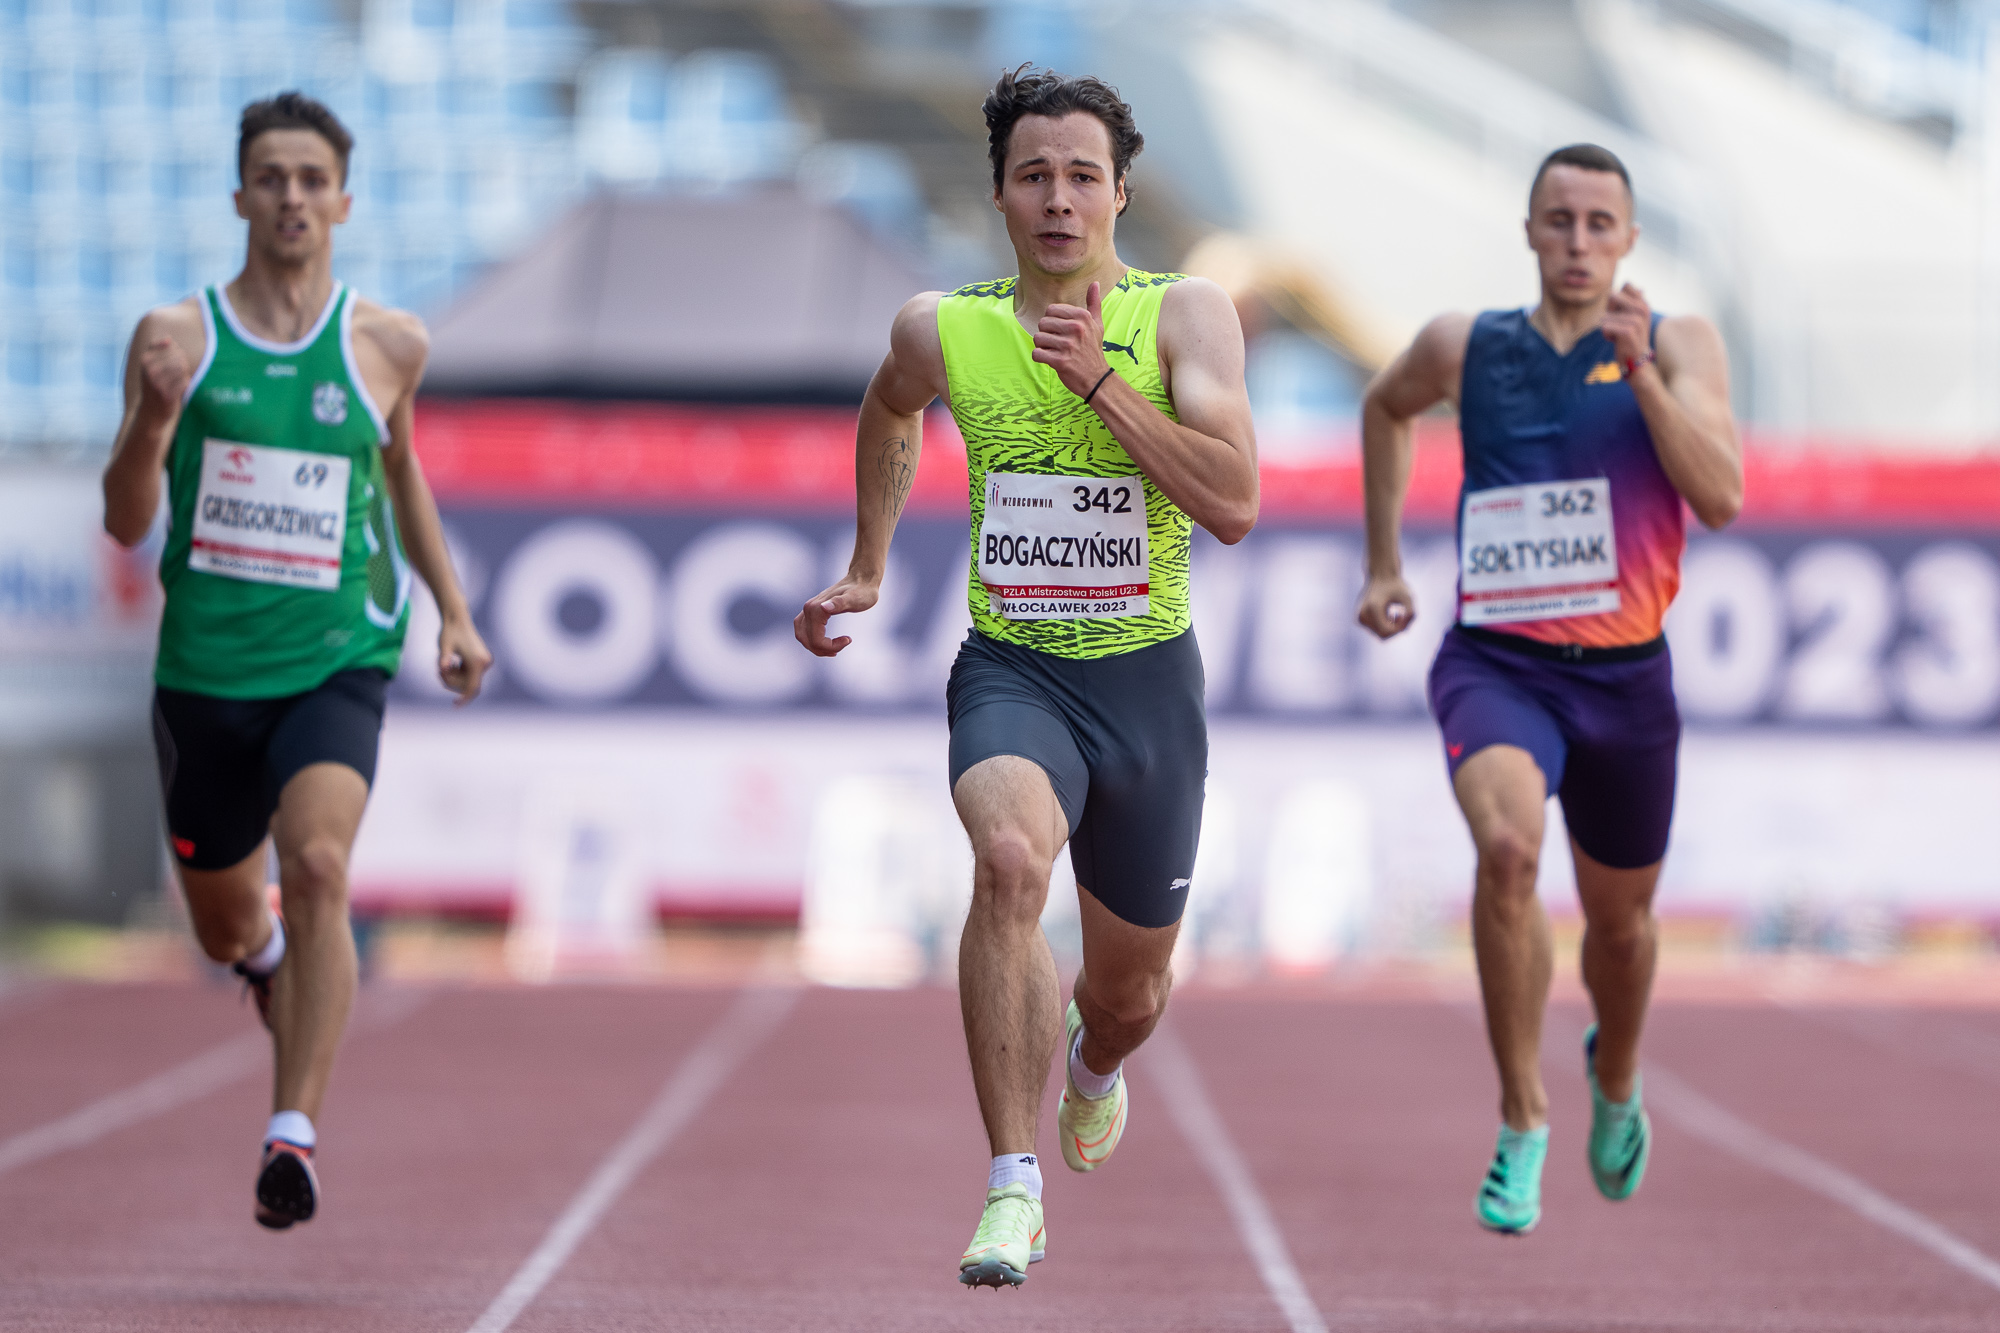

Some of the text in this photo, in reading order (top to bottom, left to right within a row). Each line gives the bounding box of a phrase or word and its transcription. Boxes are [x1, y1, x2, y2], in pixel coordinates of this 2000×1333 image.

[294, 461, 329, 489] 69
[1002, 497, 1053, 508] WZORCOWNIA
[1072, 485, 1132, 514] 342
[1541, 488, 1595, 518] 362
[202, 494, 338, 541] GRZEGORZEWICZ
[985, 531, 1141, 568] BOGACZYŃSKI
[1468, 536, 1608, 575] SOŁTYSIAK
[1003, 588, 1026, 597] PZLA
[1028, 587, 1087, 598] Mistrzostwa
[1089, 587, 1118, 598] Polski
[1119, 586, 1138, 596] U23
[1000, 600, 1127, 614] WŁOCŁAWEK 2023
